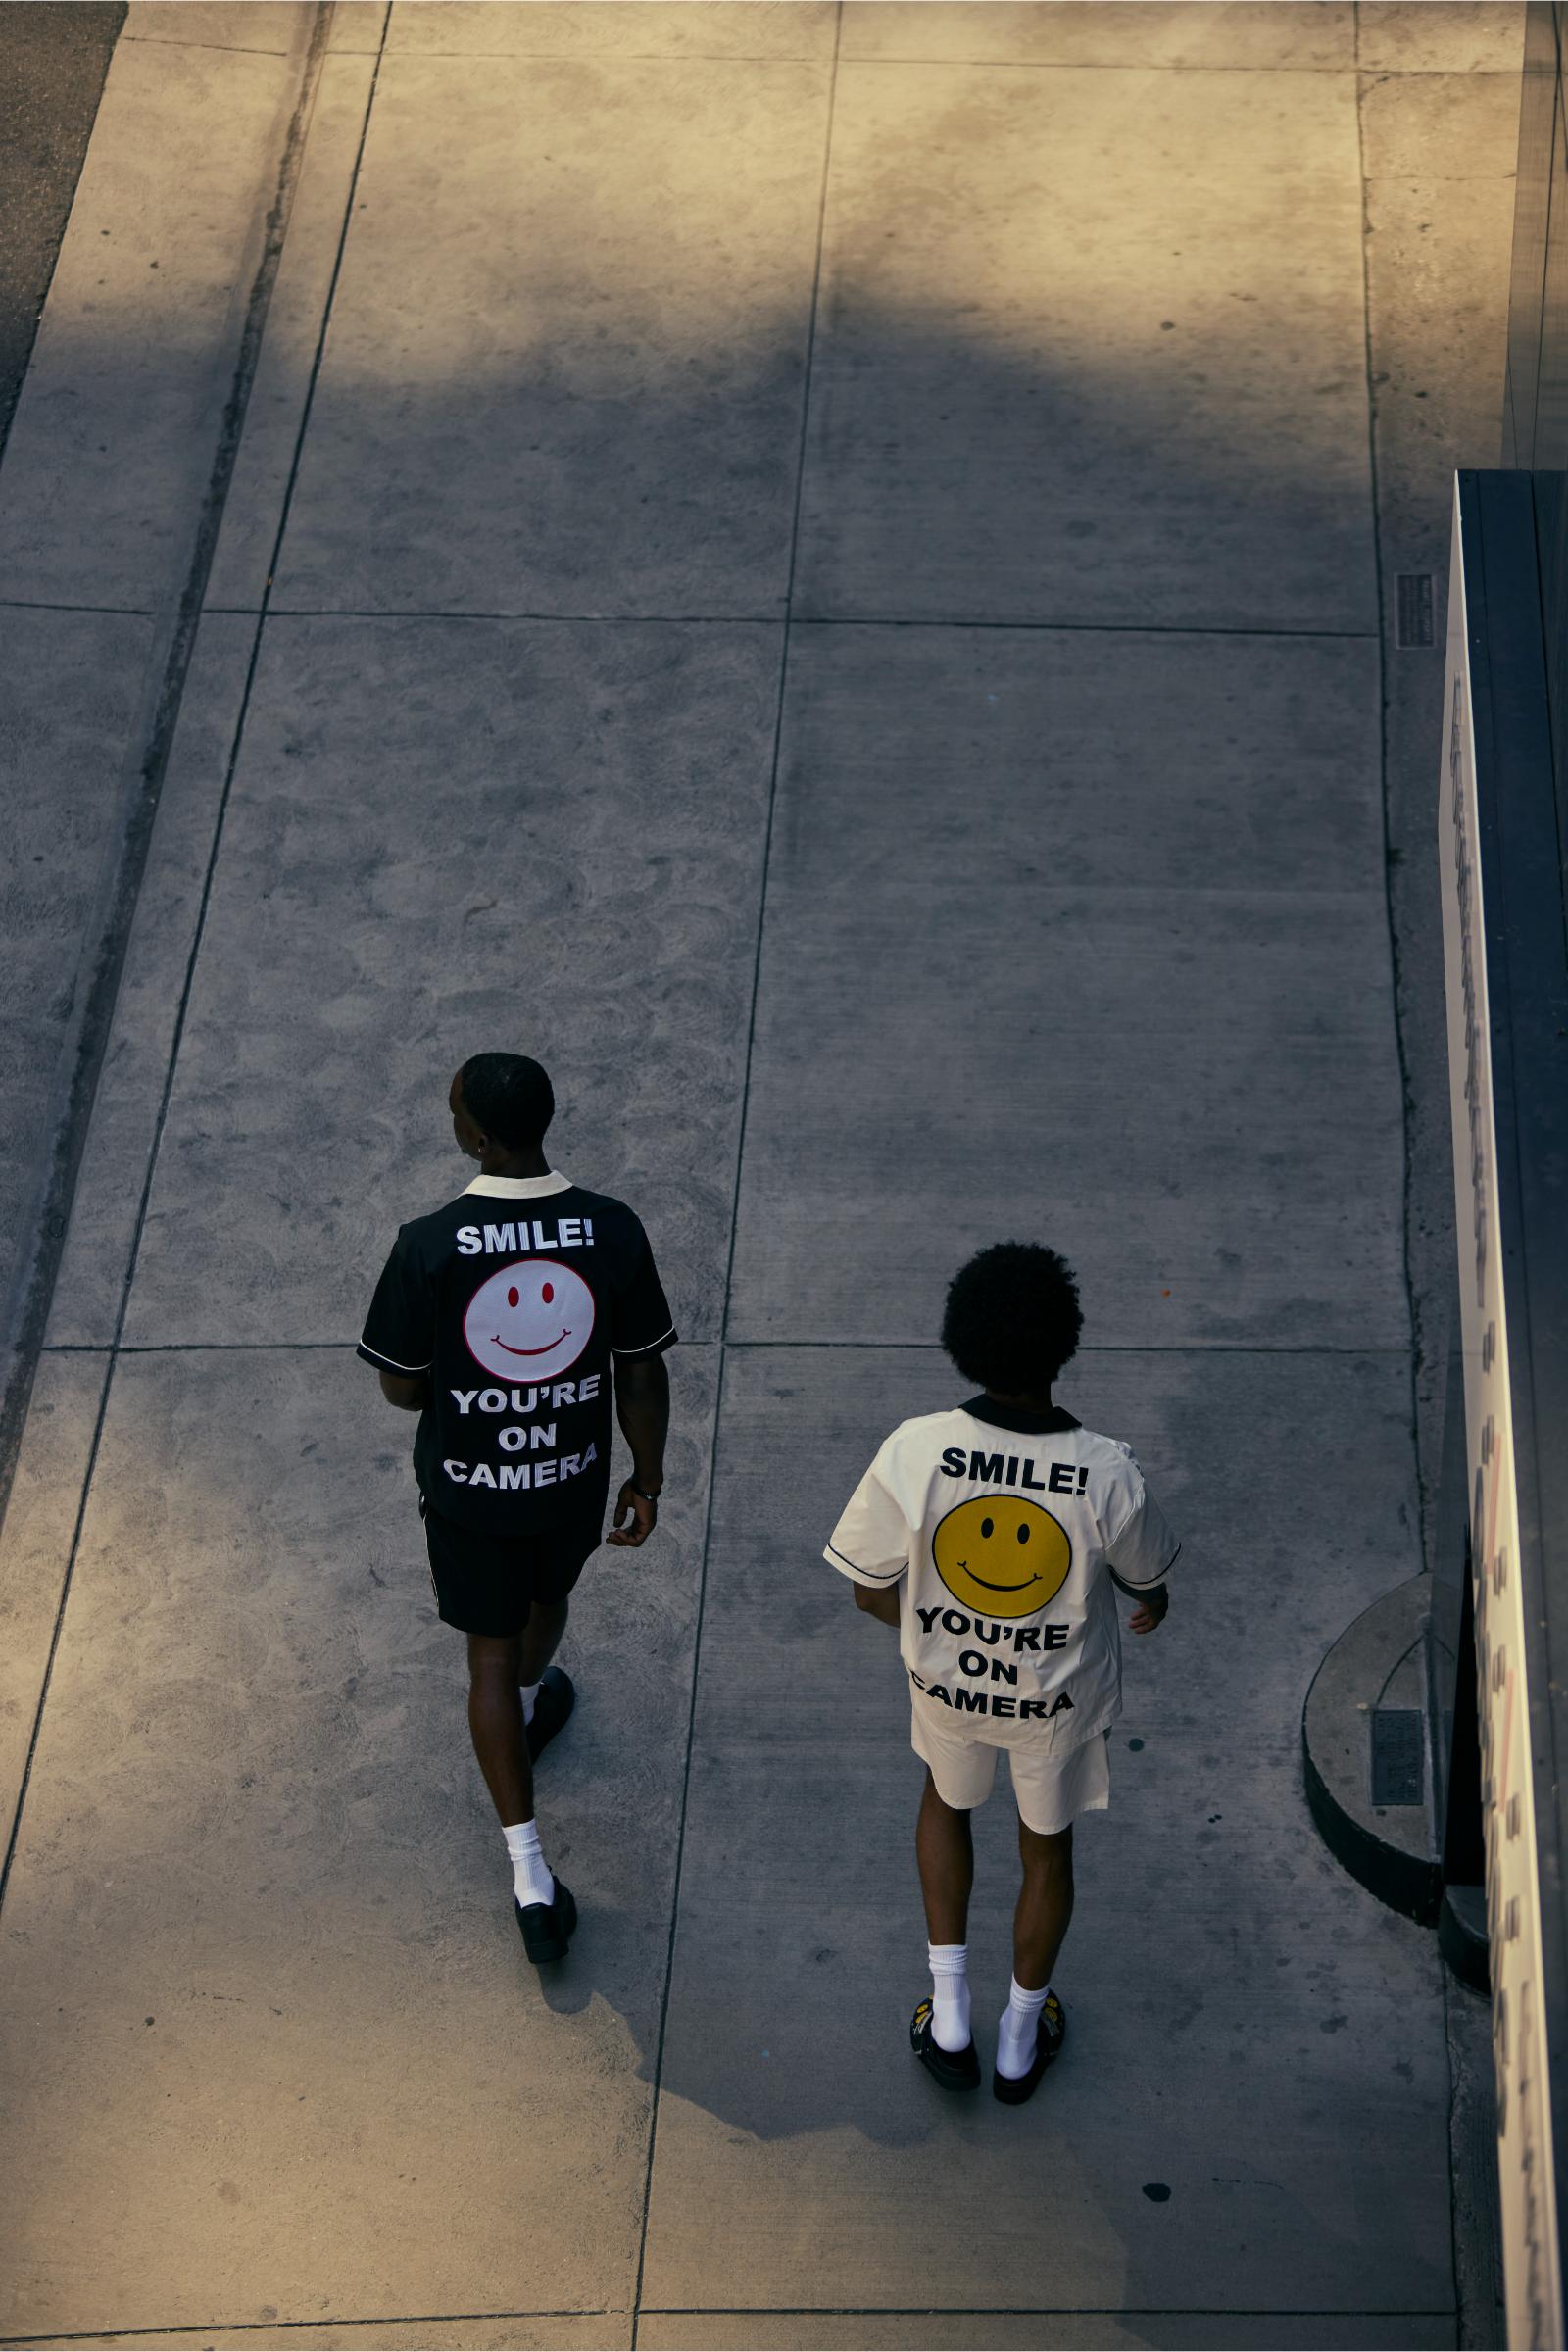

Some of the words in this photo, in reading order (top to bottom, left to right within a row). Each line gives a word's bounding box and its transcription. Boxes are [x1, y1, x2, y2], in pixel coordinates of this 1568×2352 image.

[456, 1218, 595, 1255] SMILE!
[450, 1373, 601, 1414] YOU'RE
[498, 1423, 557, 1451] ON
[443, 1442, 598, 1490] CAMERA
[940, 1447, 1089, 1495] SMILE!
[915, 1607, 1070, 1652] YOU'RE
[958, 1650, 1018, 1686] ON
[909, 1668, 1075, 1719] CAMERA
